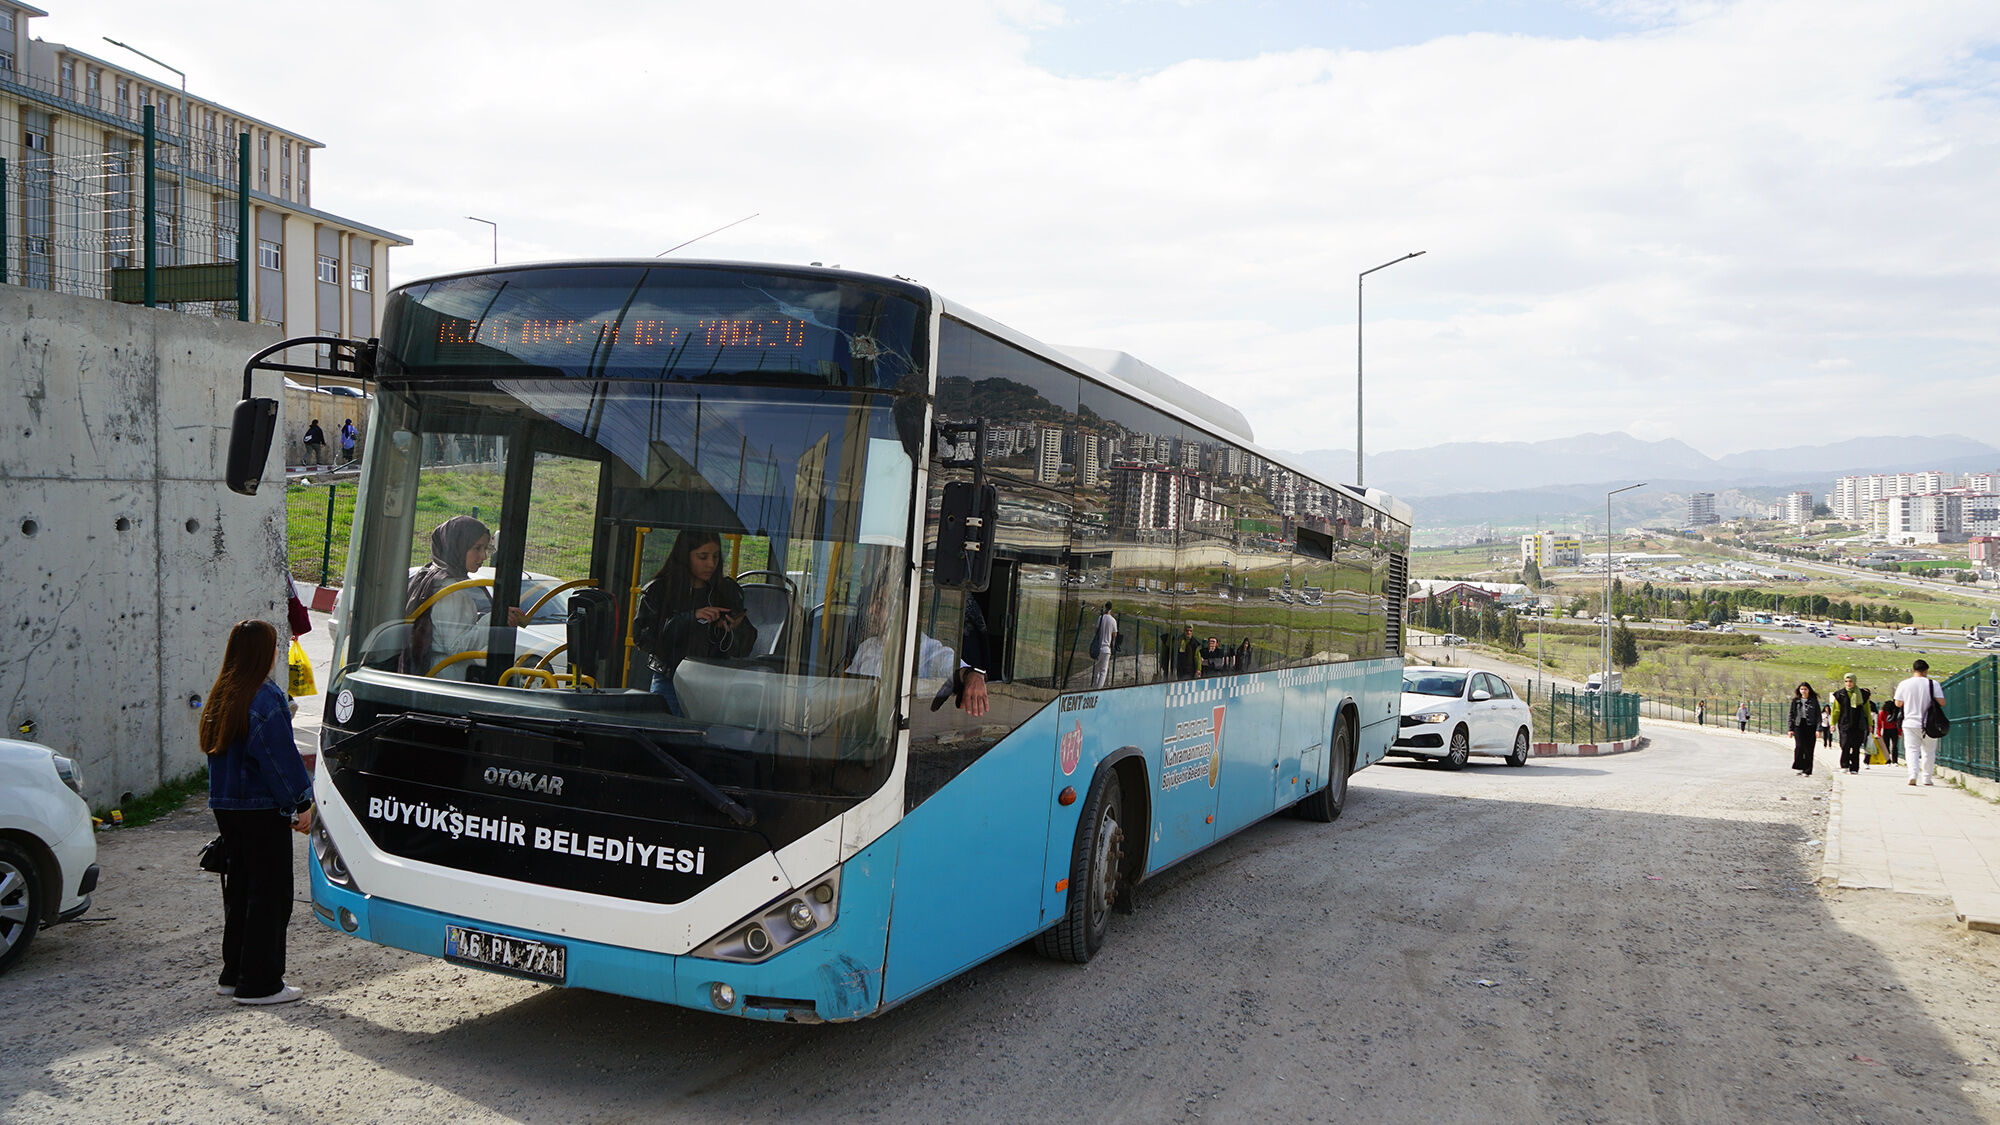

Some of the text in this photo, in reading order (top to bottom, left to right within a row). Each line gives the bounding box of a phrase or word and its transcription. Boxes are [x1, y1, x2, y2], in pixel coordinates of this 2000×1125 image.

[1061, 694, 1084, 713] KENT
[484, 767, 564, 796] OTOKAR
[368, 796, 706, 876] BÜYÜKŞEHİR BELEDİYESİ
[460, 931, 558, 974] 46 PA 771
